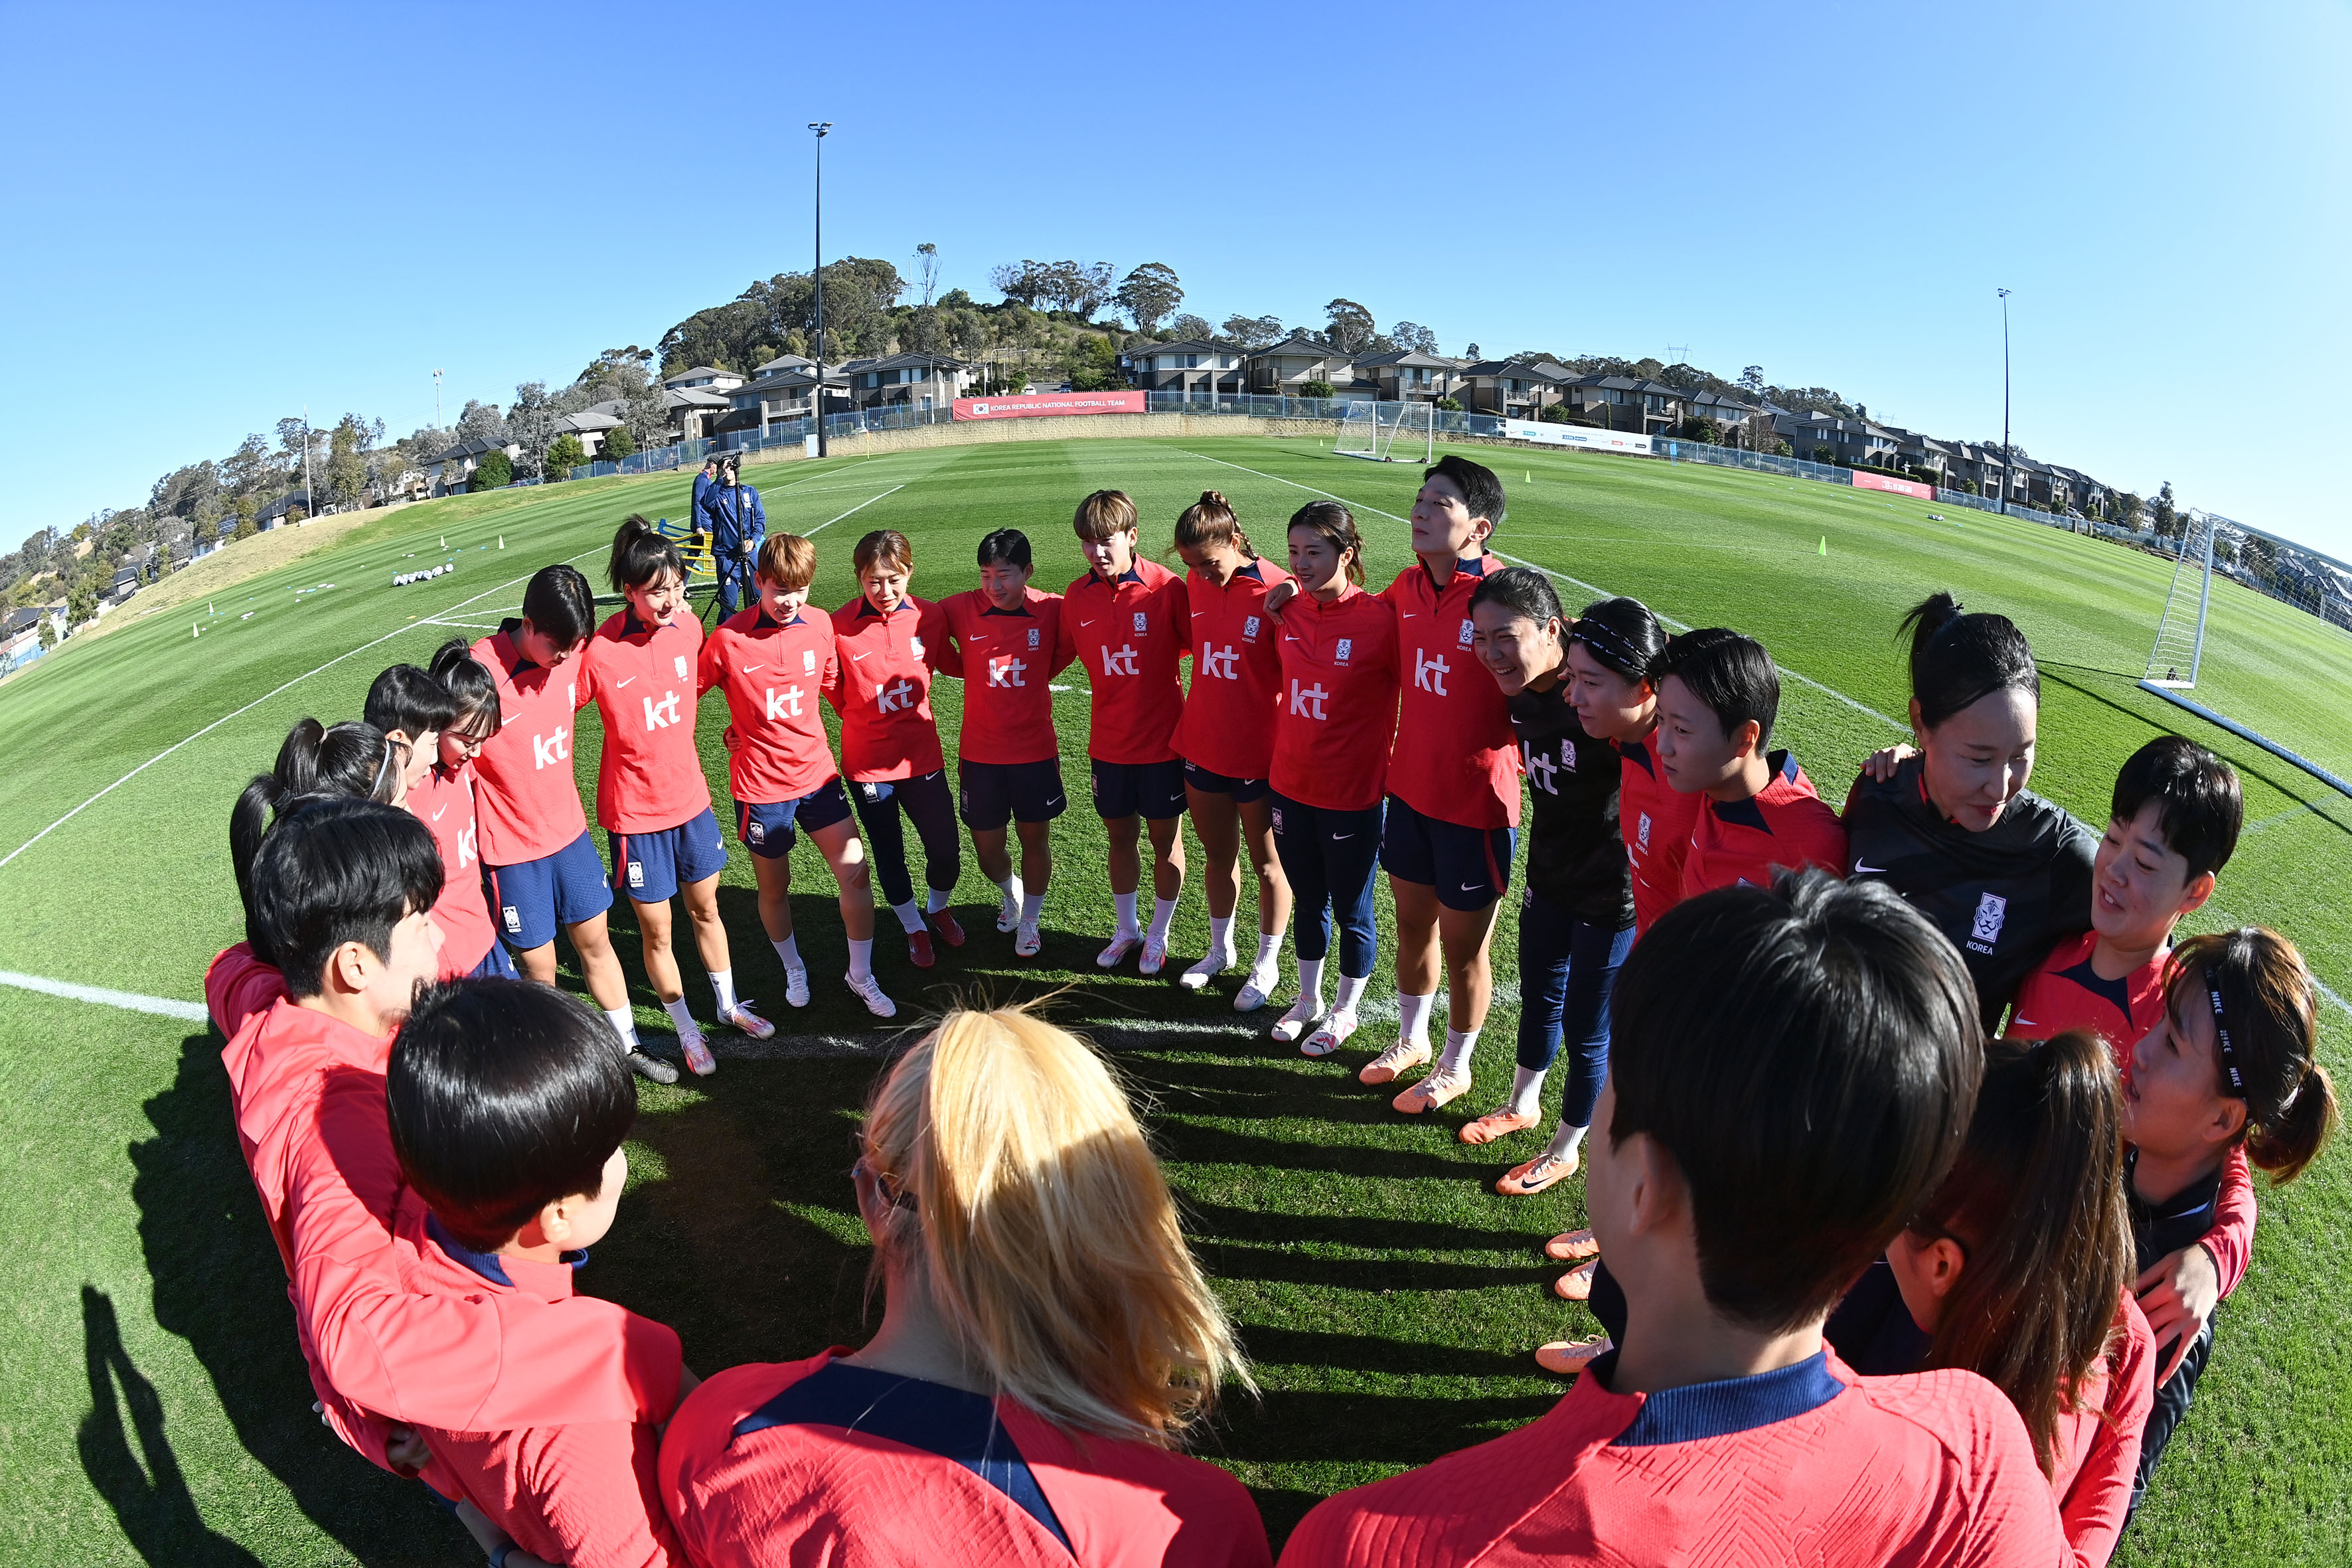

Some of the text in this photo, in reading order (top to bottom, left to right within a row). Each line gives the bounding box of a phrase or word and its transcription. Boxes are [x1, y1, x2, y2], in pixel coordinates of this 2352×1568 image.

[989, 658, 1026, 688] kt
[1101, 644, 1139, 676] kt
[1202, 641, 1239, 680] kt
[1415, 648, 1450, 696] kt
[643, 690, 680, 731] kt
[766, 684, 804, 720] kt
[876, 679, 913, 714] kt
[1291, 678, 1328, 720] kt
[533, 725, 568, 770] kt
[1524, 740, 1558, 795] kt
[1561, 764, 1577, 773] KOREA
[1635, 841, 1648, 856] KOREA
[1966, 940, 1993, 955] KOREA
[2211, 991, 2223, 1014] NIKE
[2219, 1030, 2232, 1053] NIKE
[2229, 1067, 2242, 1087] NIKE
